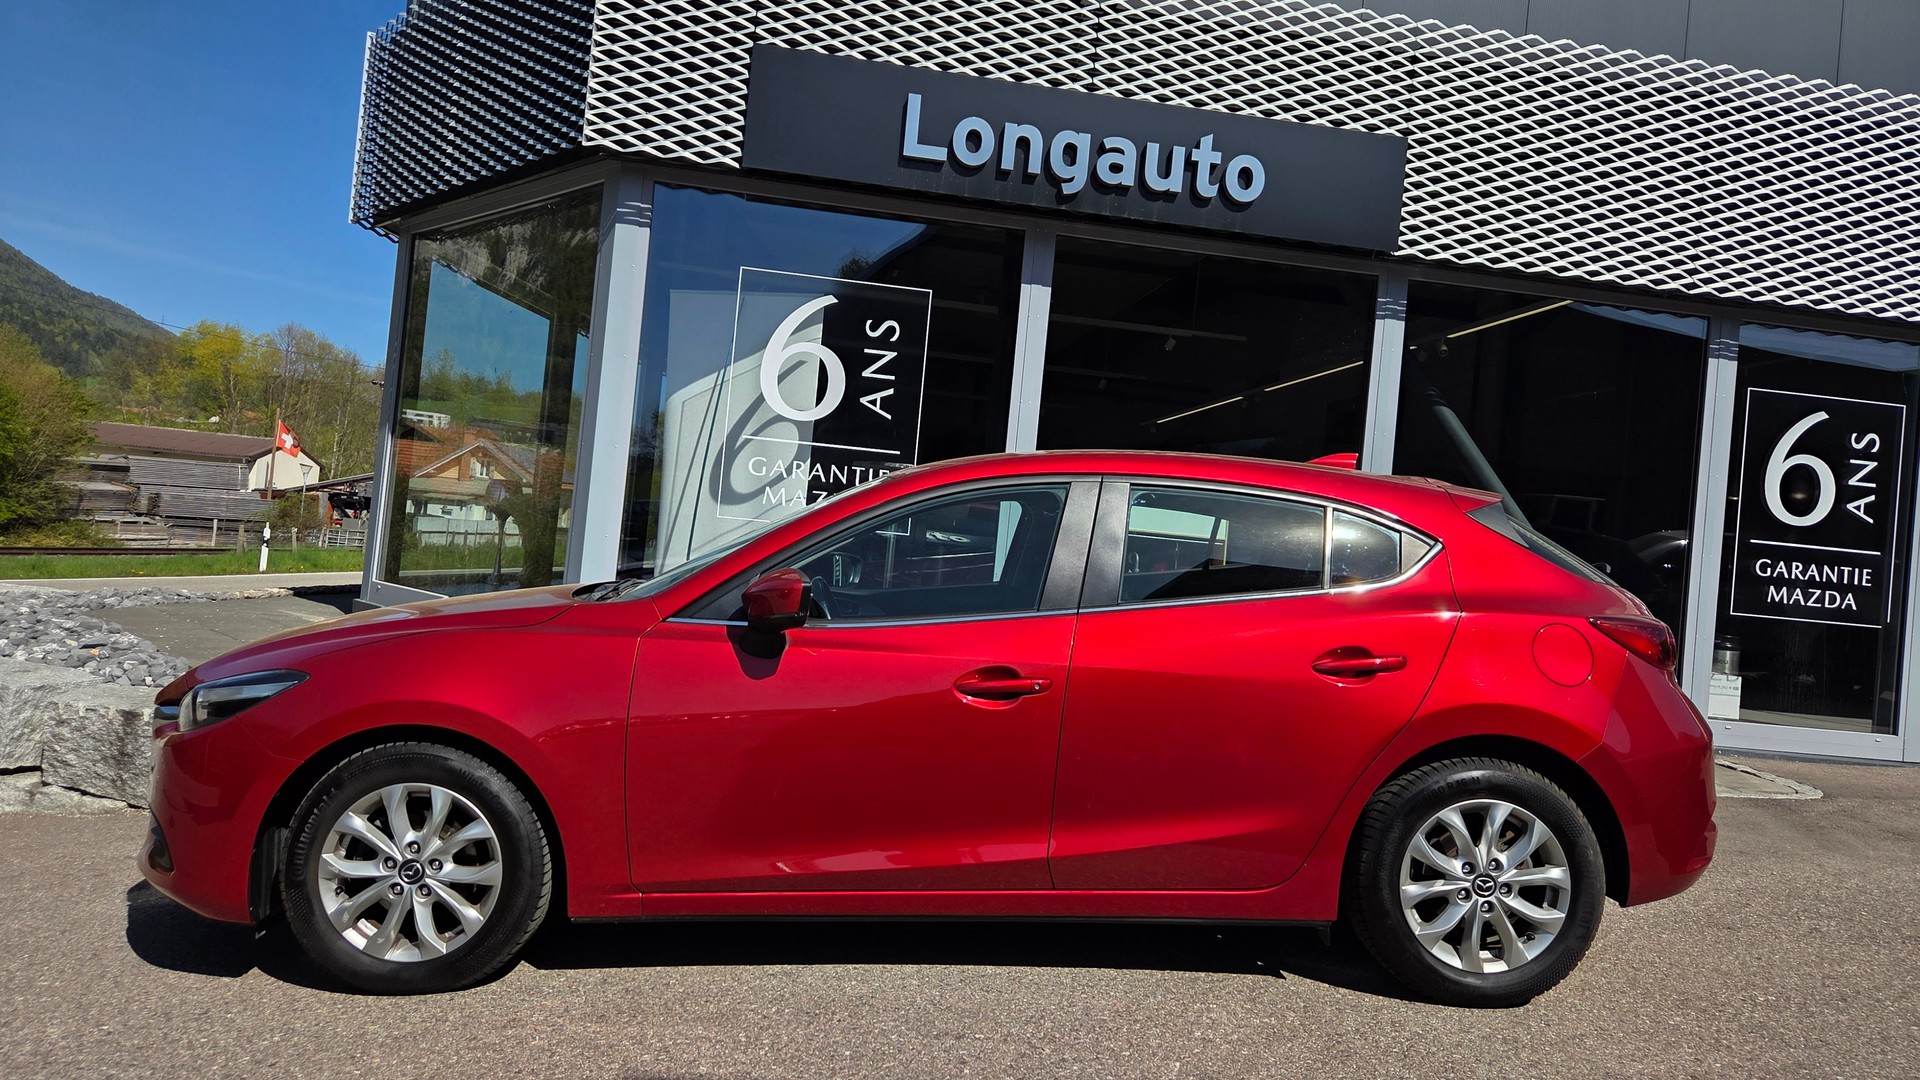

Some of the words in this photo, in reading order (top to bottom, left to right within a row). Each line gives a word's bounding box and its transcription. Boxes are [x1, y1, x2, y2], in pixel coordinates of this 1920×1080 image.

[902, 92, 1267, 204] Longauto
[759, 294, 846, 422] 6
[859, 319, 901, 420] ANS
[762, 486, 830, 508] MAZ
[1763, 411, 1836, 527] 6
[1846, 432, 1880, 524] ANS
[1755, 558, 1873, 587] GARANTIE
[1767, 585, 1857, 611] MAZDA
